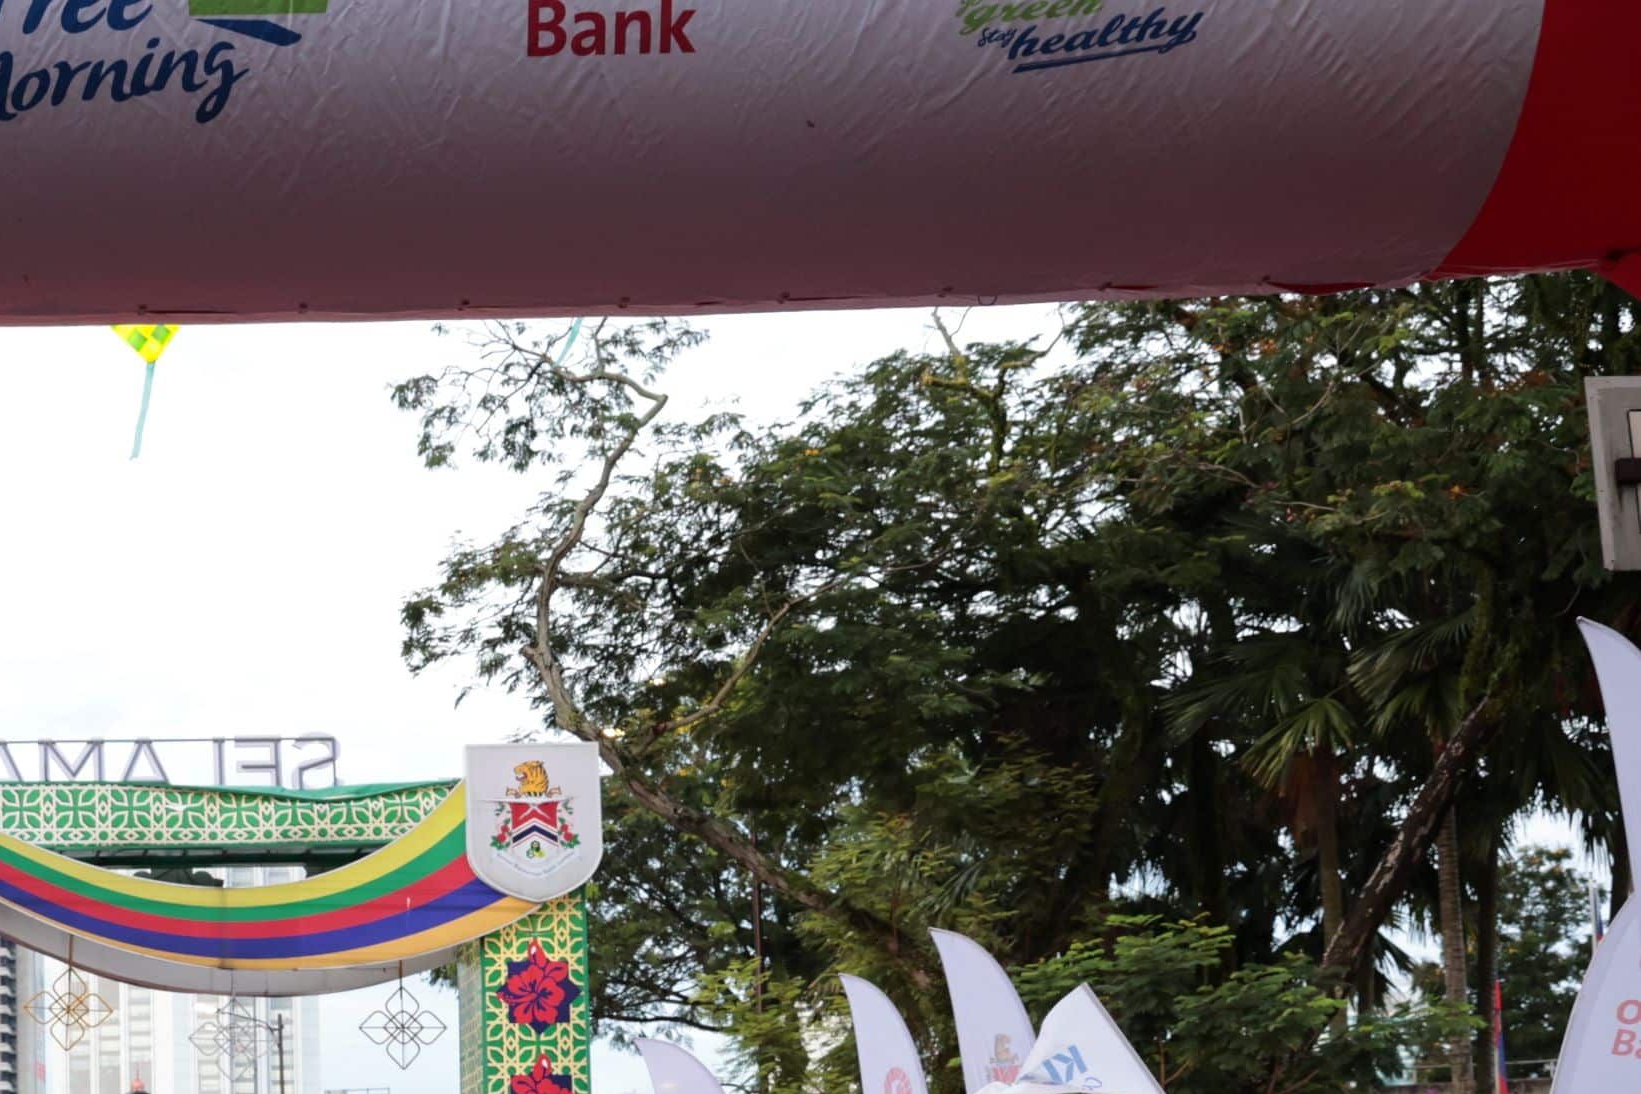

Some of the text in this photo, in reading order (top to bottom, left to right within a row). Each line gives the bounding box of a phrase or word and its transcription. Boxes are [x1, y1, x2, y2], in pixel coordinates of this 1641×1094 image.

[526, 0, 696, 57] Bank
[976, 7, 1205, 60] Stay healthy
